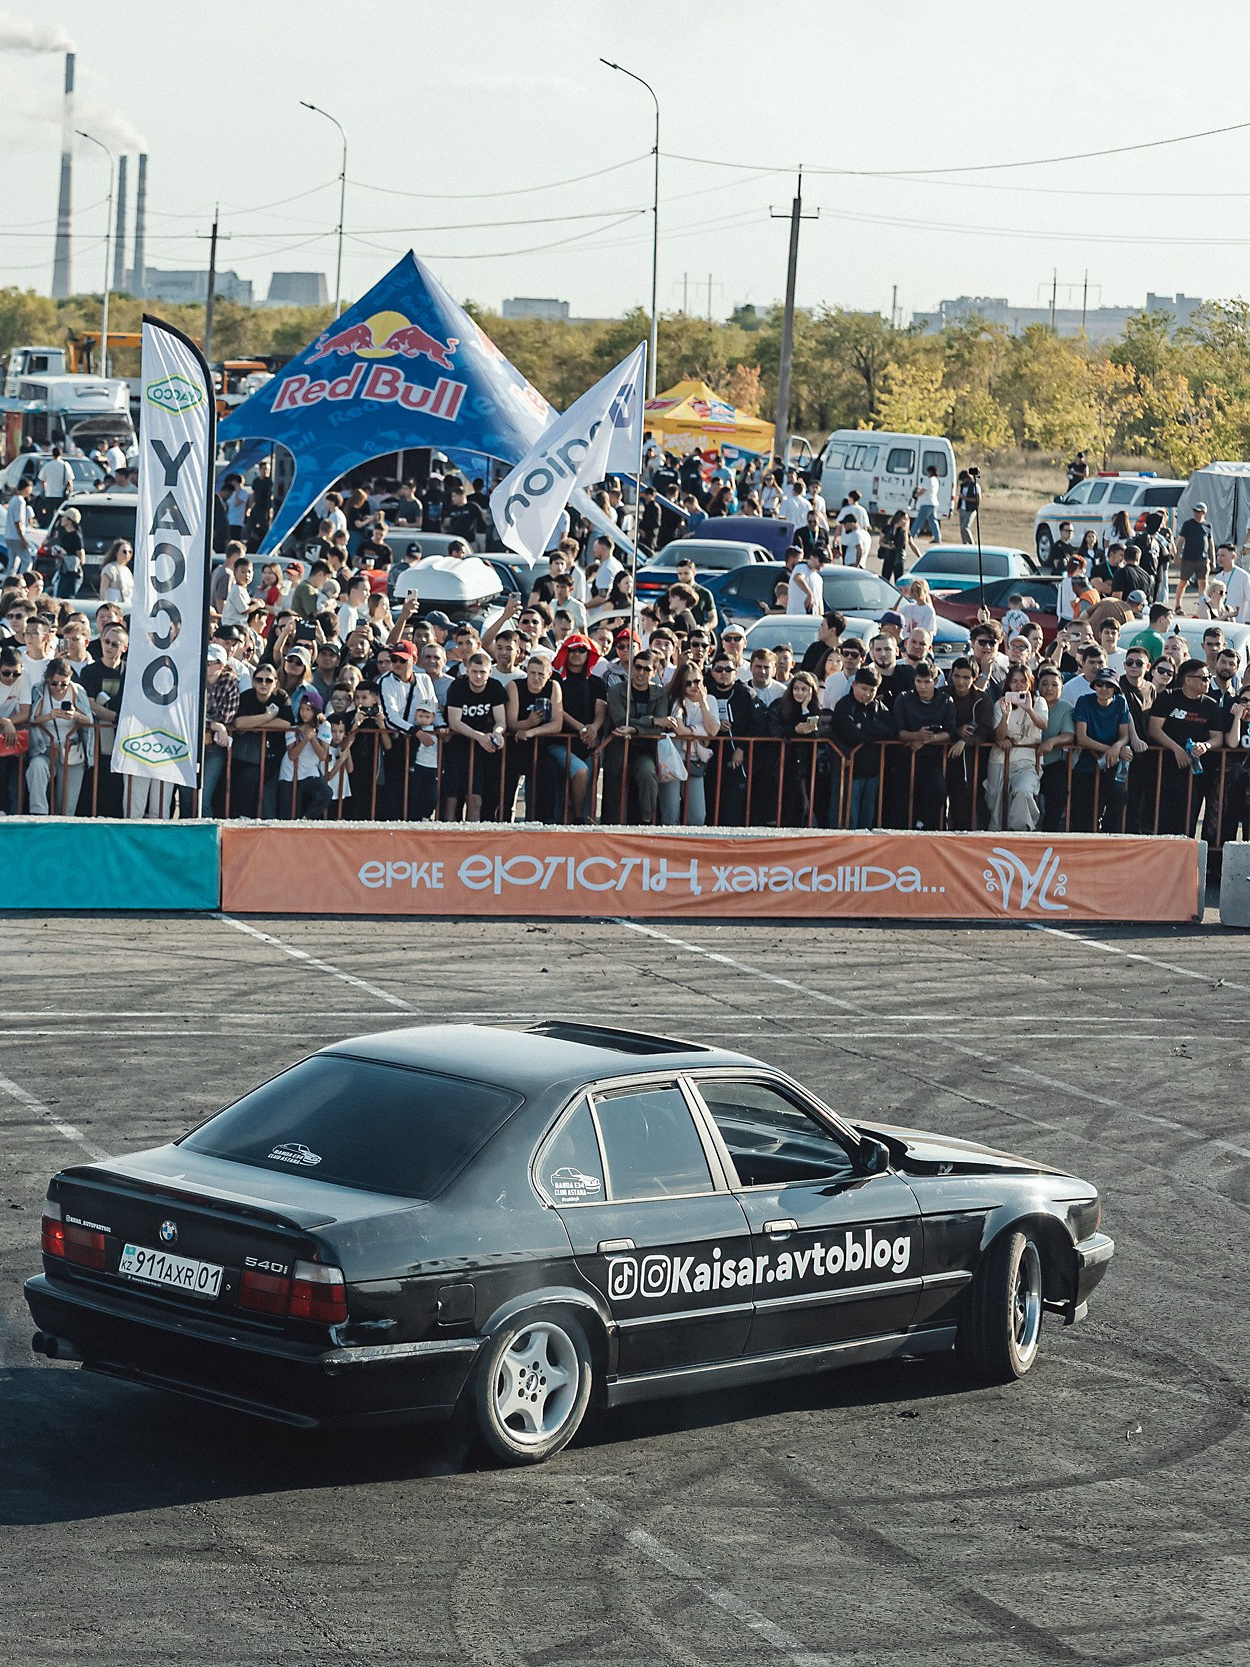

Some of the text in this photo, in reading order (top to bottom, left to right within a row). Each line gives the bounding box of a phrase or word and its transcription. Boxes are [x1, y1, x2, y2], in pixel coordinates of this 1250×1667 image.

[270, 362, 368, 413] Red
[360, 364, 468, 421] Bull
[462, 703, 490, 717] BOSS
[122, 1260, 133, 1271] KZ
[198, 1267, 221, 1292] 01
[670, 1229, 910, 1294] Kaisar.avtoblog
